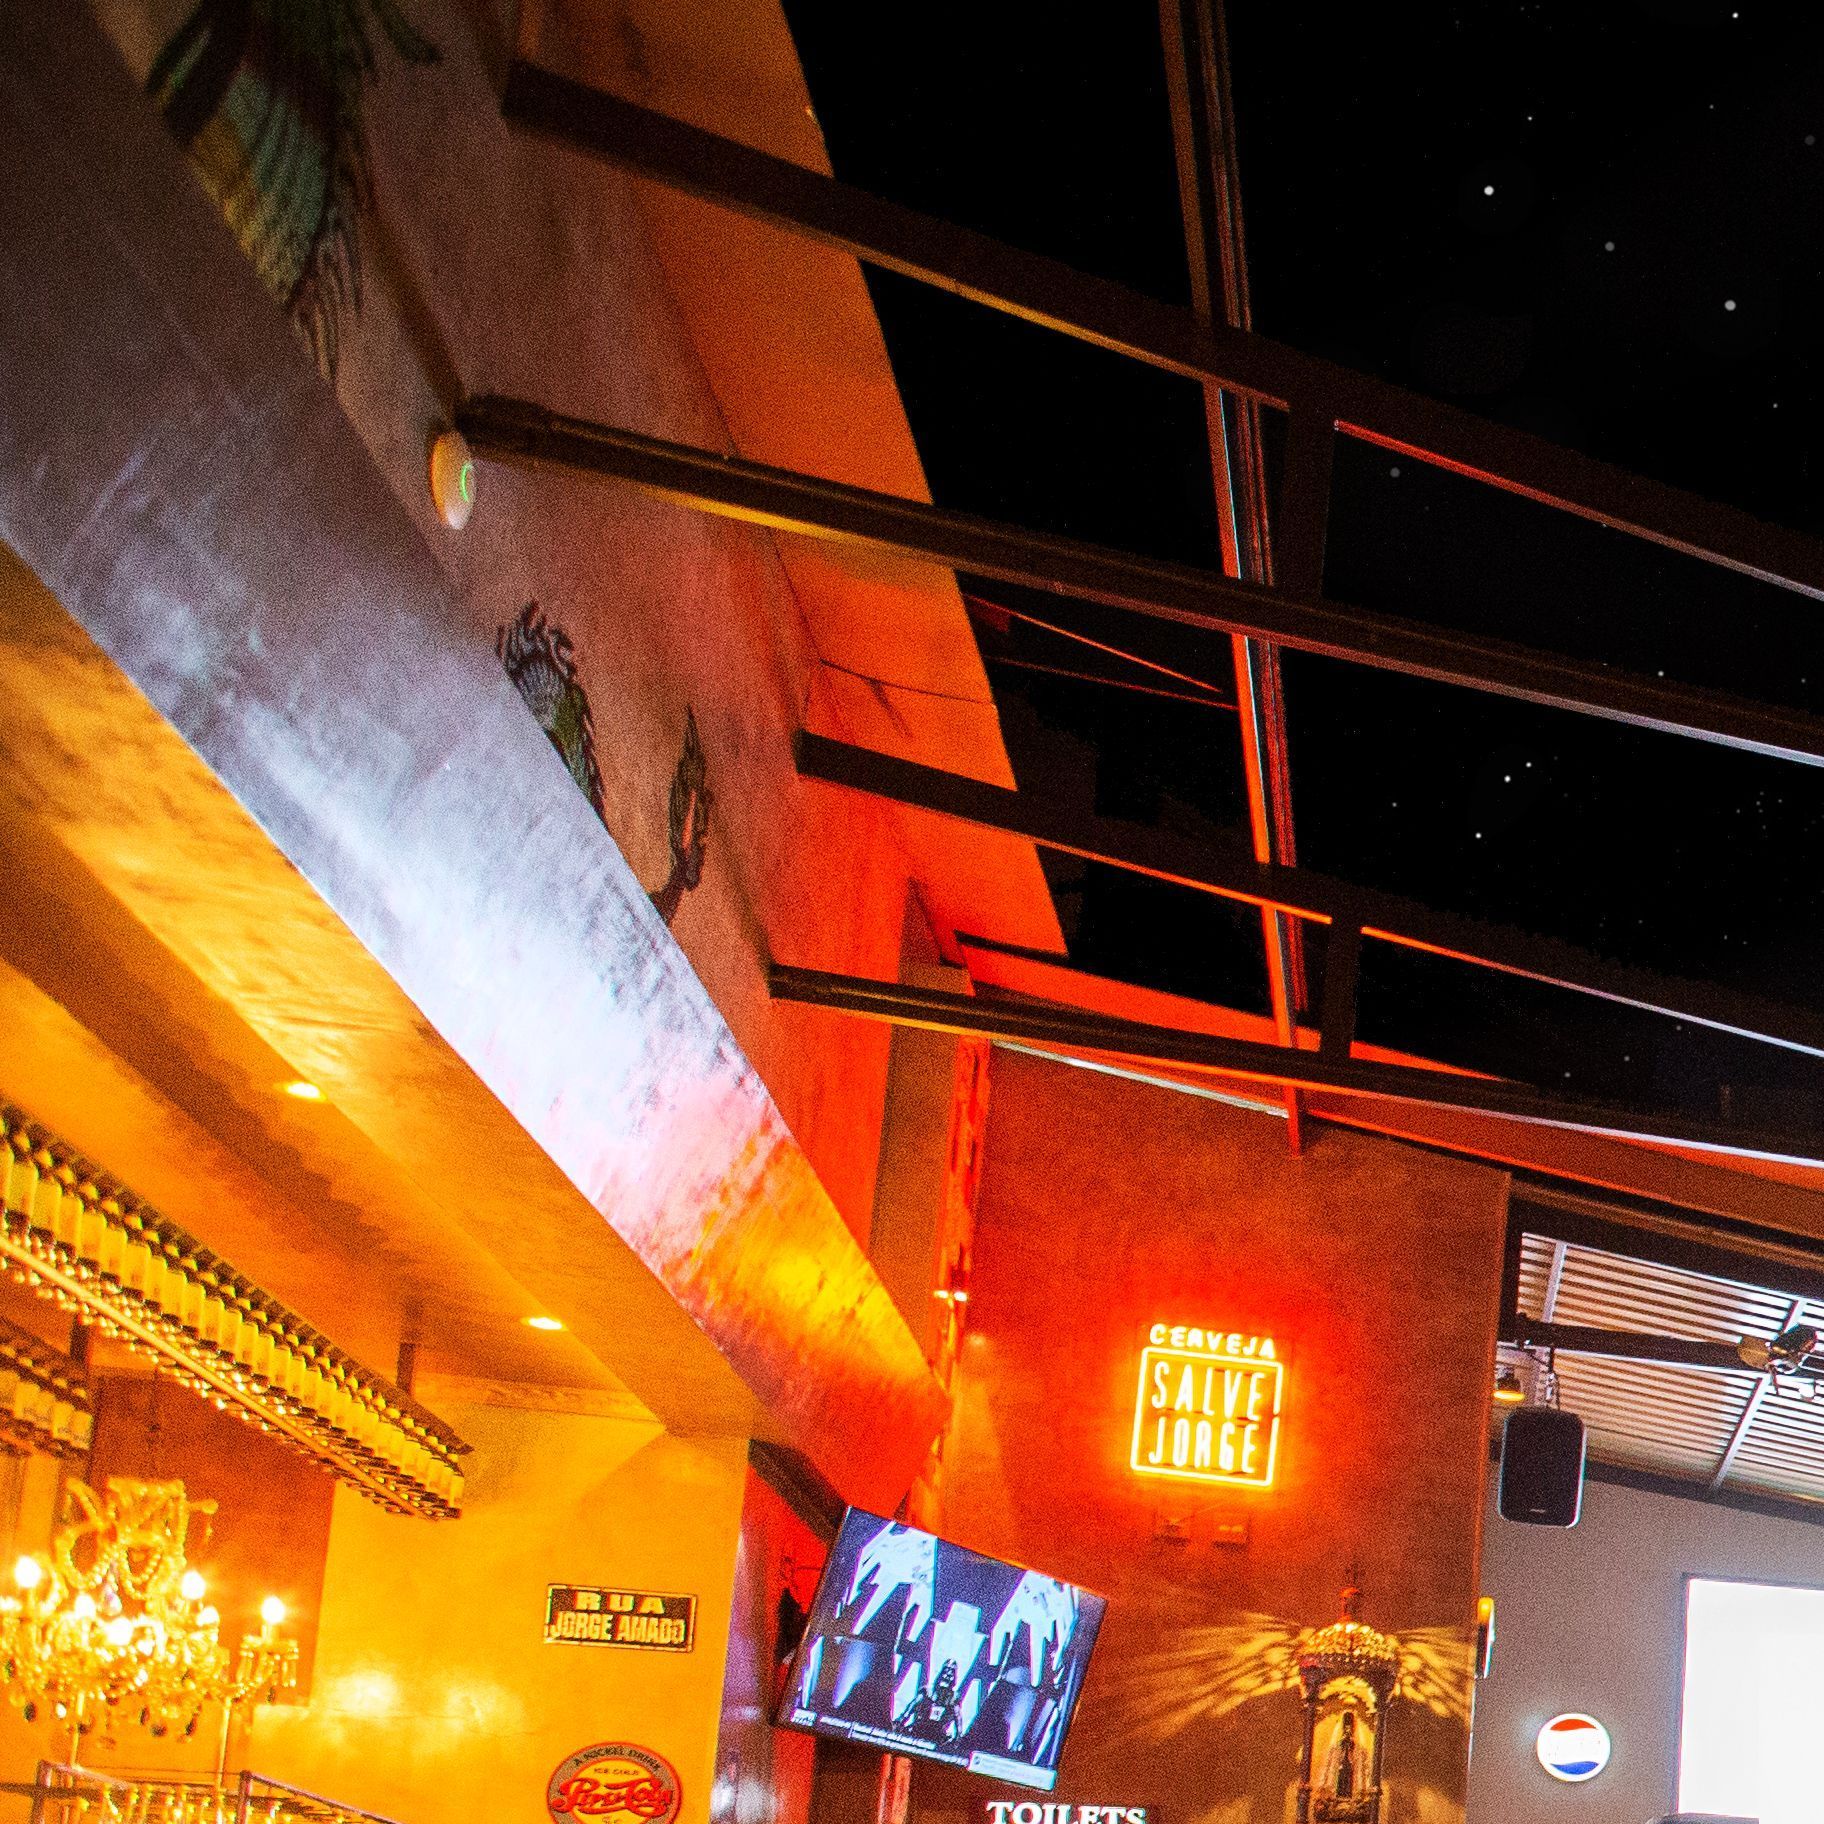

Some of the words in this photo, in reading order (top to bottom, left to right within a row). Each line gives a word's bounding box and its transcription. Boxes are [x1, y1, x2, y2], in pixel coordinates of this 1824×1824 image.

[1149, 1323, 1276, 1360] CERVEJA
[1151, 1361, 1266, 1422] SALVE
[1148, 1417, 1260, 1474] JORGE
[575, 1591, 665, 1615] RUA
[551, 1611, 614, 1641] JORGE
